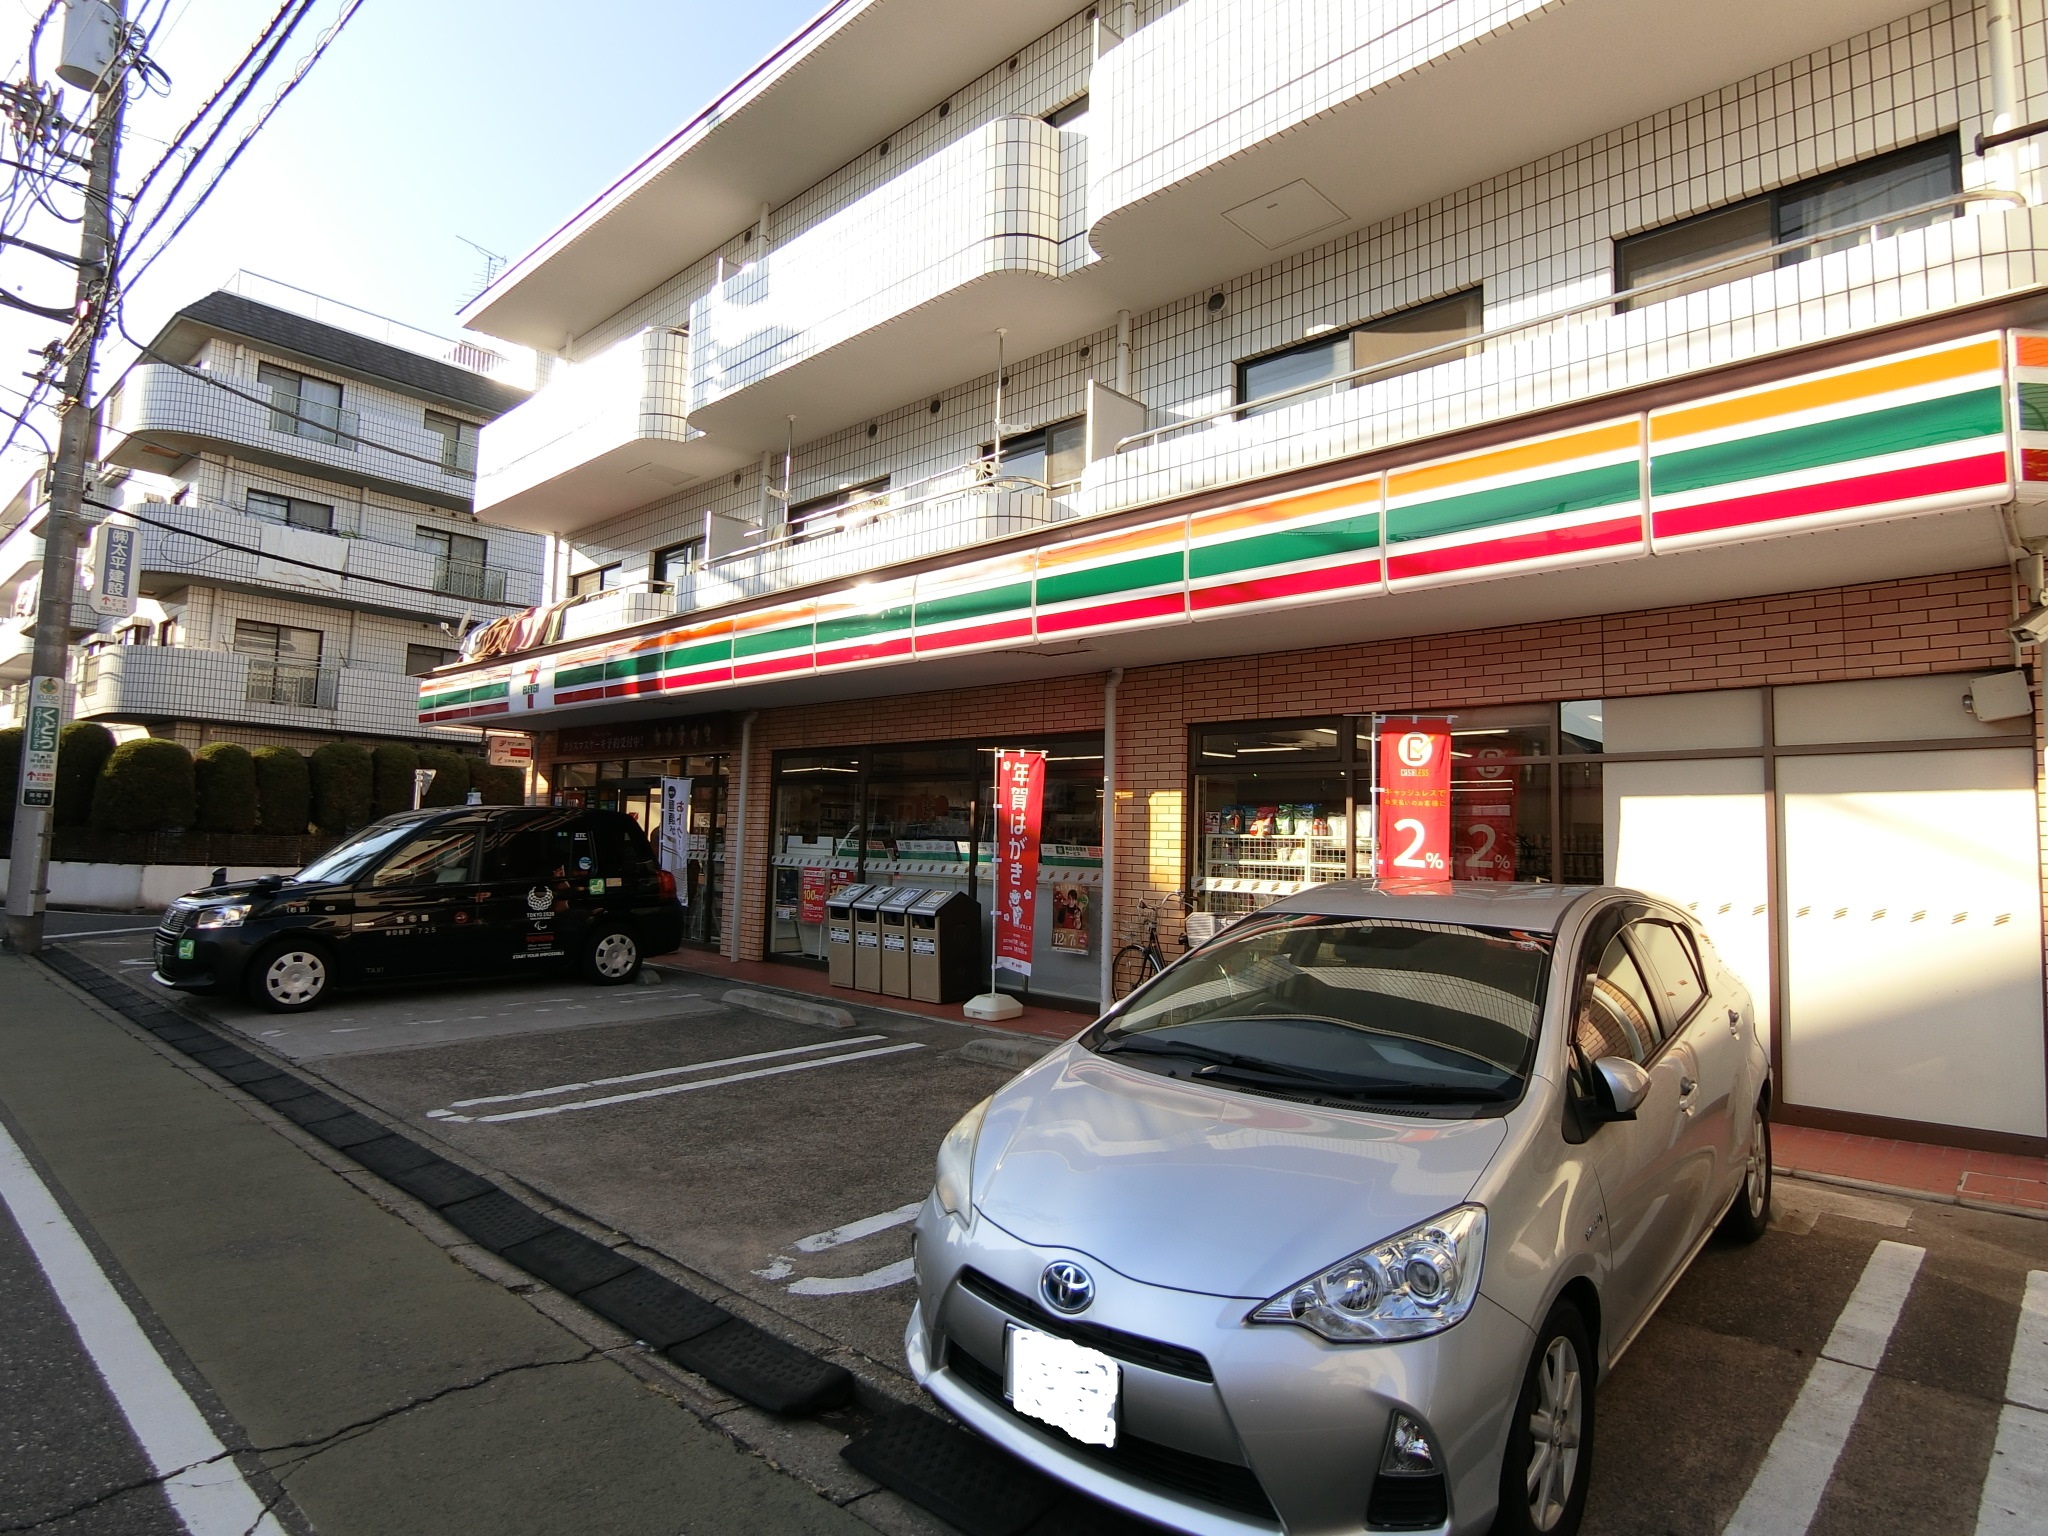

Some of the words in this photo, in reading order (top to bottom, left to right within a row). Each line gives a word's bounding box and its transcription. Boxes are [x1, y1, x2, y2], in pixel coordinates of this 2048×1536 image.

[39, 709, 57, 749] くどう
[1400, 768, 1429, 777] CASHLESS
[1384, 788, 1446, 798] キャッシュレスで
[1384, 799, 1446, 808] お支払いのお客様に
[1009, 761, 1030, 886] 年賀はがき
[1393, 818, 1444, 870] 2%
[366, 966, 384, 974] TAXI
